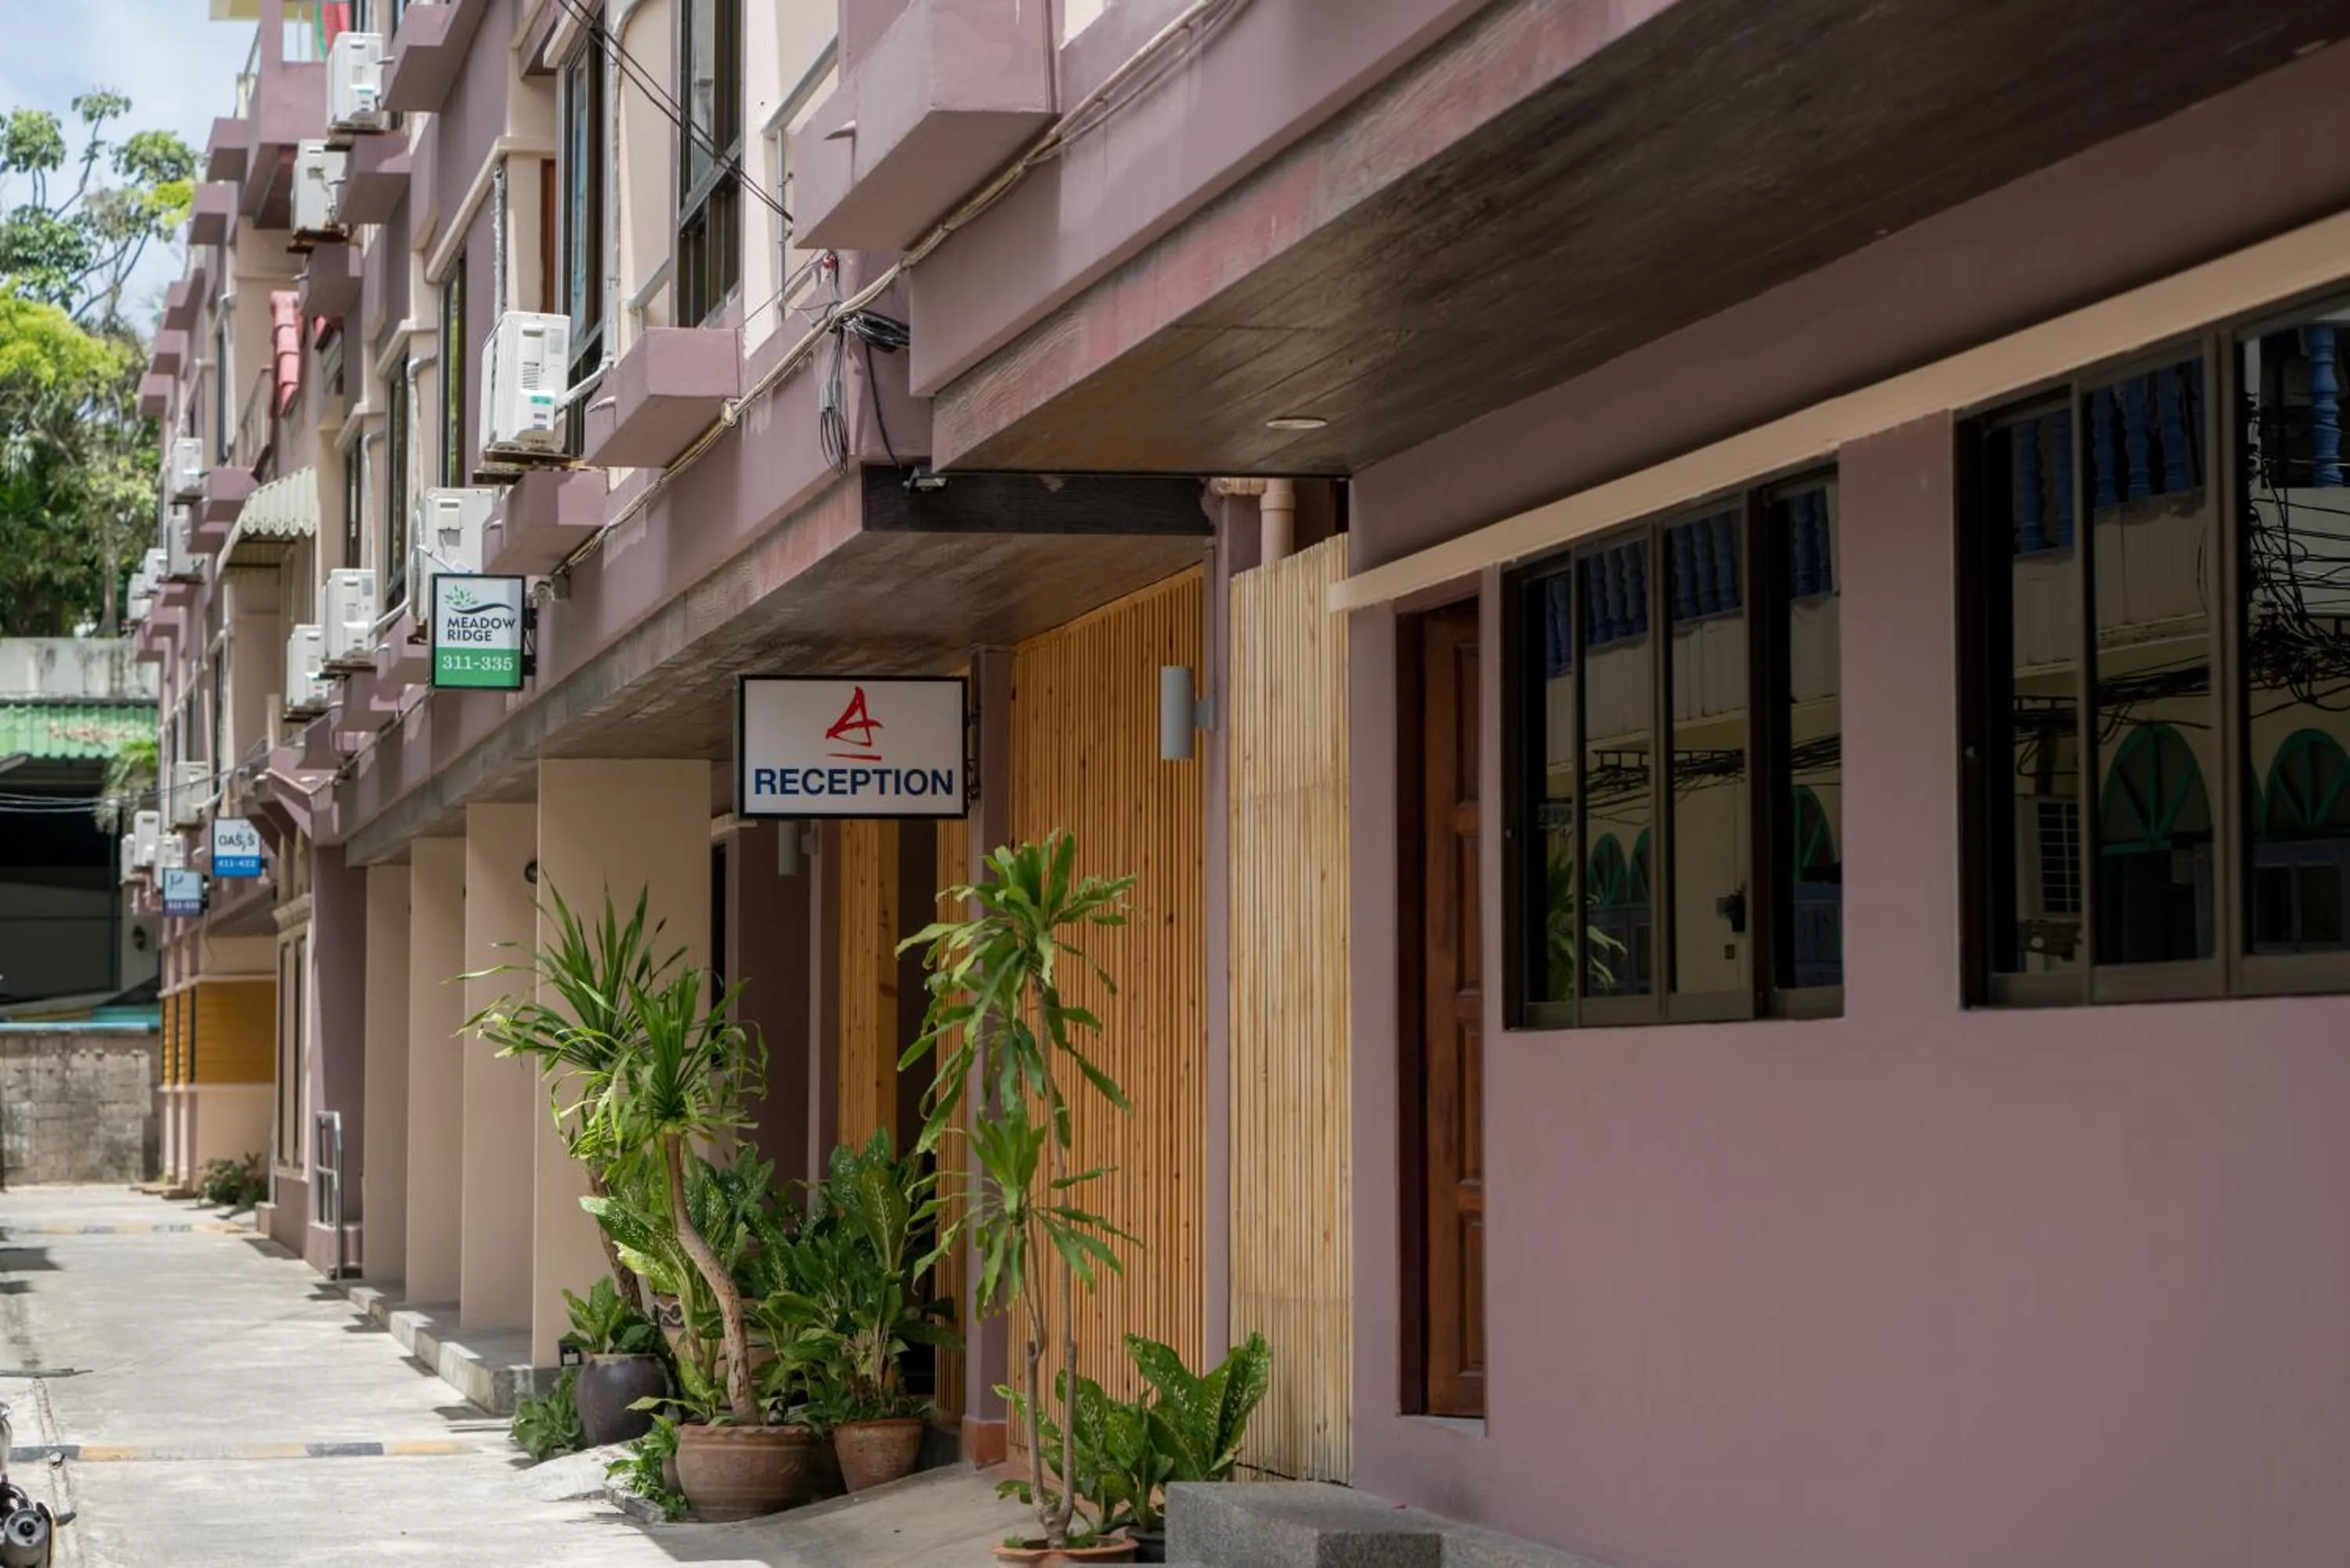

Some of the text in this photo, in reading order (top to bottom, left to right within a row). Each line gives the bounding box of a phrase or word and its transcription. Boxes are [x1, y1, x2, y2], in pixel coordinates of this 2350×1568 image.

[447, 616, 516, 630] MEADOW
[447, 630, 493, 641] RIDGE
[443, 655, 513, 671] 311-335
[754, 768, 953, 796] RECEPTION
